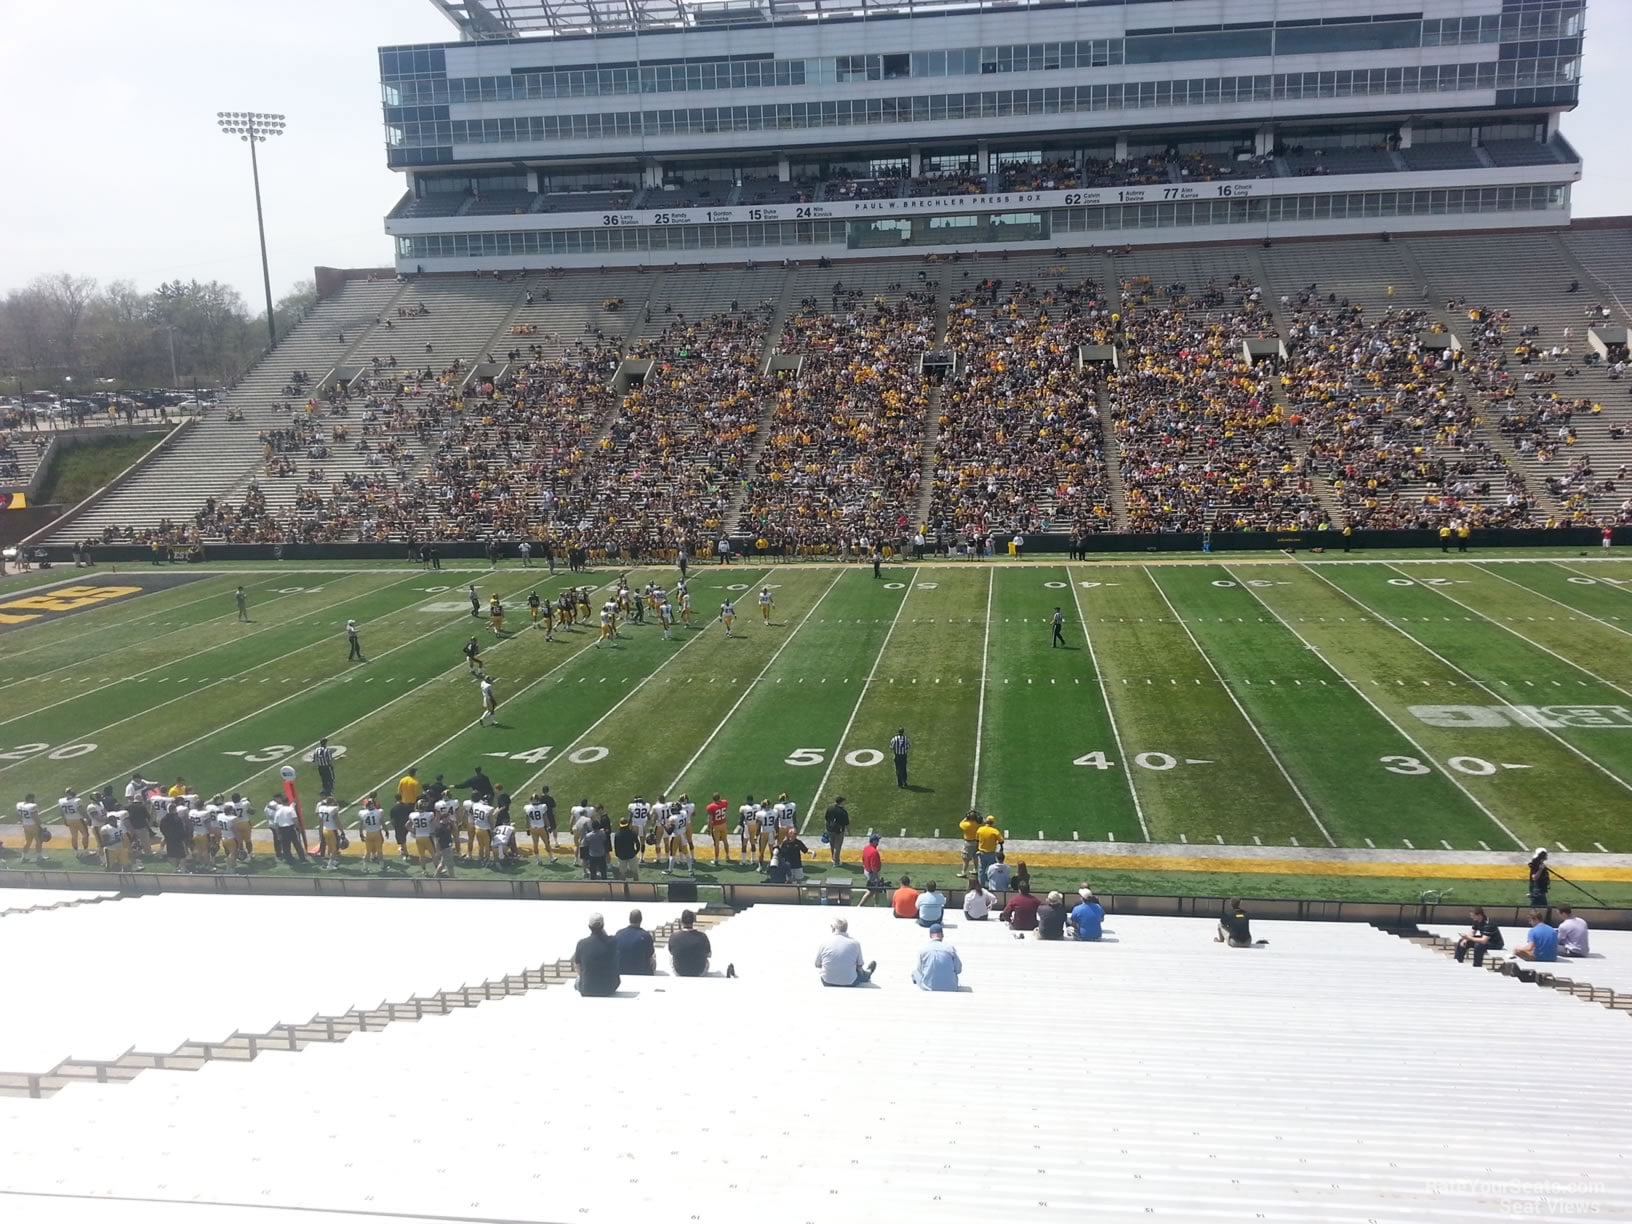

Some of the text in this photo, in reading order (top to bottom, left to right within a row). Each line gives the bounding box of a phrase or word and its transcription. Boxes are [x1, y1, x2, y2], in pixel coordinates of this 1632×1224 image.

[1164, 188, 1179, 199] 77
[1217, 186, 1232, 196] 16
[1065, 193, 1081, 204] 62
[1118, 192, 1123, 202] 1
[903, 198, 964, 207] BRECHLER
[707, 212, 711, 221] 1
[749, 210, 762, 220] 15
[796, 208, 811, 218] 24
[603, 215, 619, 225] 36
[655, 214, 670, 224] 25
[883, 582, 939, 590] 50
[1044, 580, 1102, 589] 40
[0, 743, 98, 760] 20
[244, 745, 348, 762] 30
[509, 746, 610, 764] 40
[784, 748, 884, 767] 50
[1072, 751, 1178, 771] 40
[1380, 756, 1497, 776] 30
[61, 805, 76, 814] 75
[154, 800, 167, 811] 94
[474, 810, 485, 821] 50
[529, 810, 542, 820] 48
[634, 808, 647, 818] 32
[715, 808, 726, 820] 25
[782, 809, 792, 820] 12
[365, 816, 376, 826] 41
[414, 818, 427, 828] 36
[764, 816, 775, 826] 13
